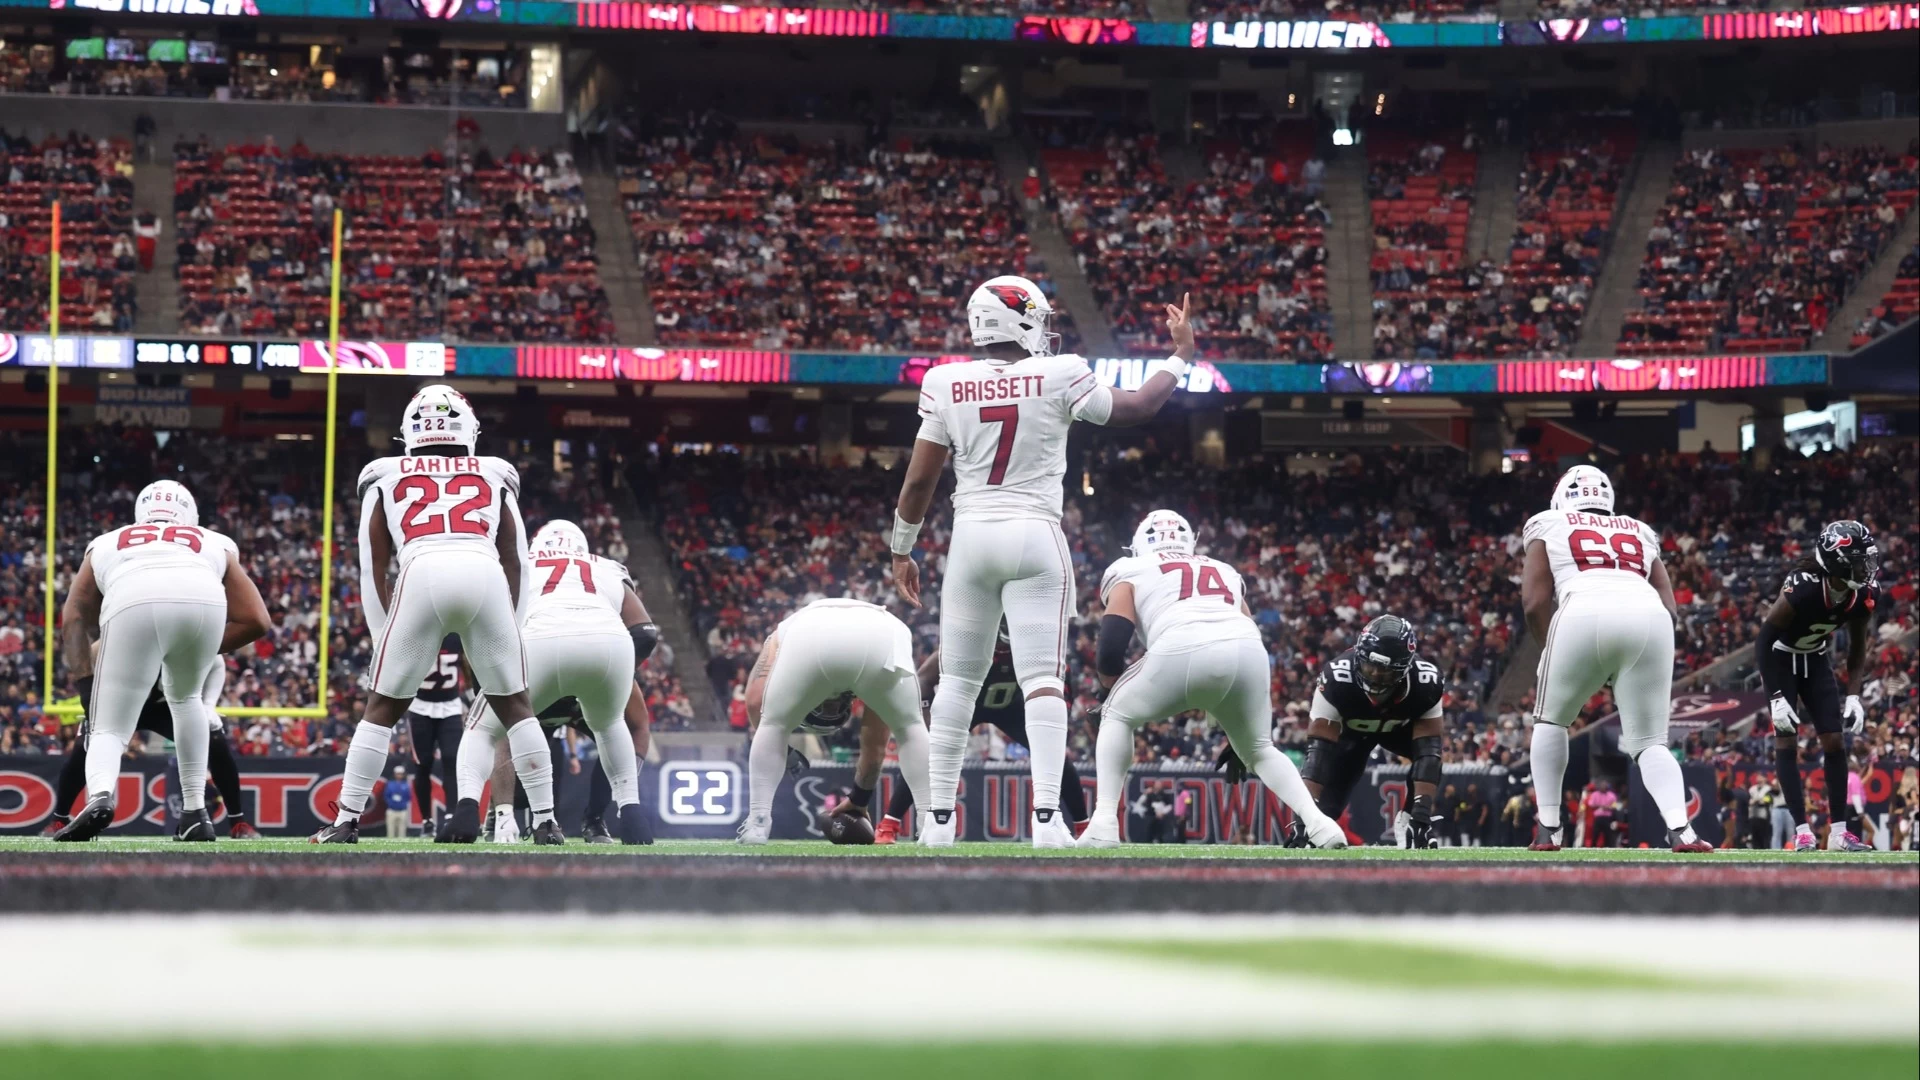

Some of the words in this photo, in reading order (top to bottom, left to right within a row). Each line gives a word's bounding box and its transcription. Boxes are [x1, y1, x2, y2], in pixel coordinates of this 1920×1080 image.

[974, 315, 981, 328] 7
[186, 343, 200, 363] 4
[138, 388, 187, 402] LIGHT
[951, 375, 1045, 404] BRISSETT
[424, 418, 445, 431] 22
[416, 435, 456, 444] CARDINALS
[979, 403, 1019, 486] 7
[399, 457, 480, 474] CARTER
[154, 491, 173, 502] 66
[1582, 486, 1599, 497] 68
[393, 474, 493, 545] 22
[1566, 512, 1640, 533] BEACHUM
[116, 524, 205, 554] 66
[557, 537, 572, 547] 71
[1159, 531, 1176, 542] 74
[1568, 529, 1648, 578] 68
[535, 558, 597, 597] 71
[1159, 562, 1236, 606] 74
[1794, 623, 1838, 650] 2
[1330, 658, 1353, 684] 90
[1415, 660, 1439, 685] 90
[983, 681, 1017, 709] 0
[672, 770, 729, 815] 22
